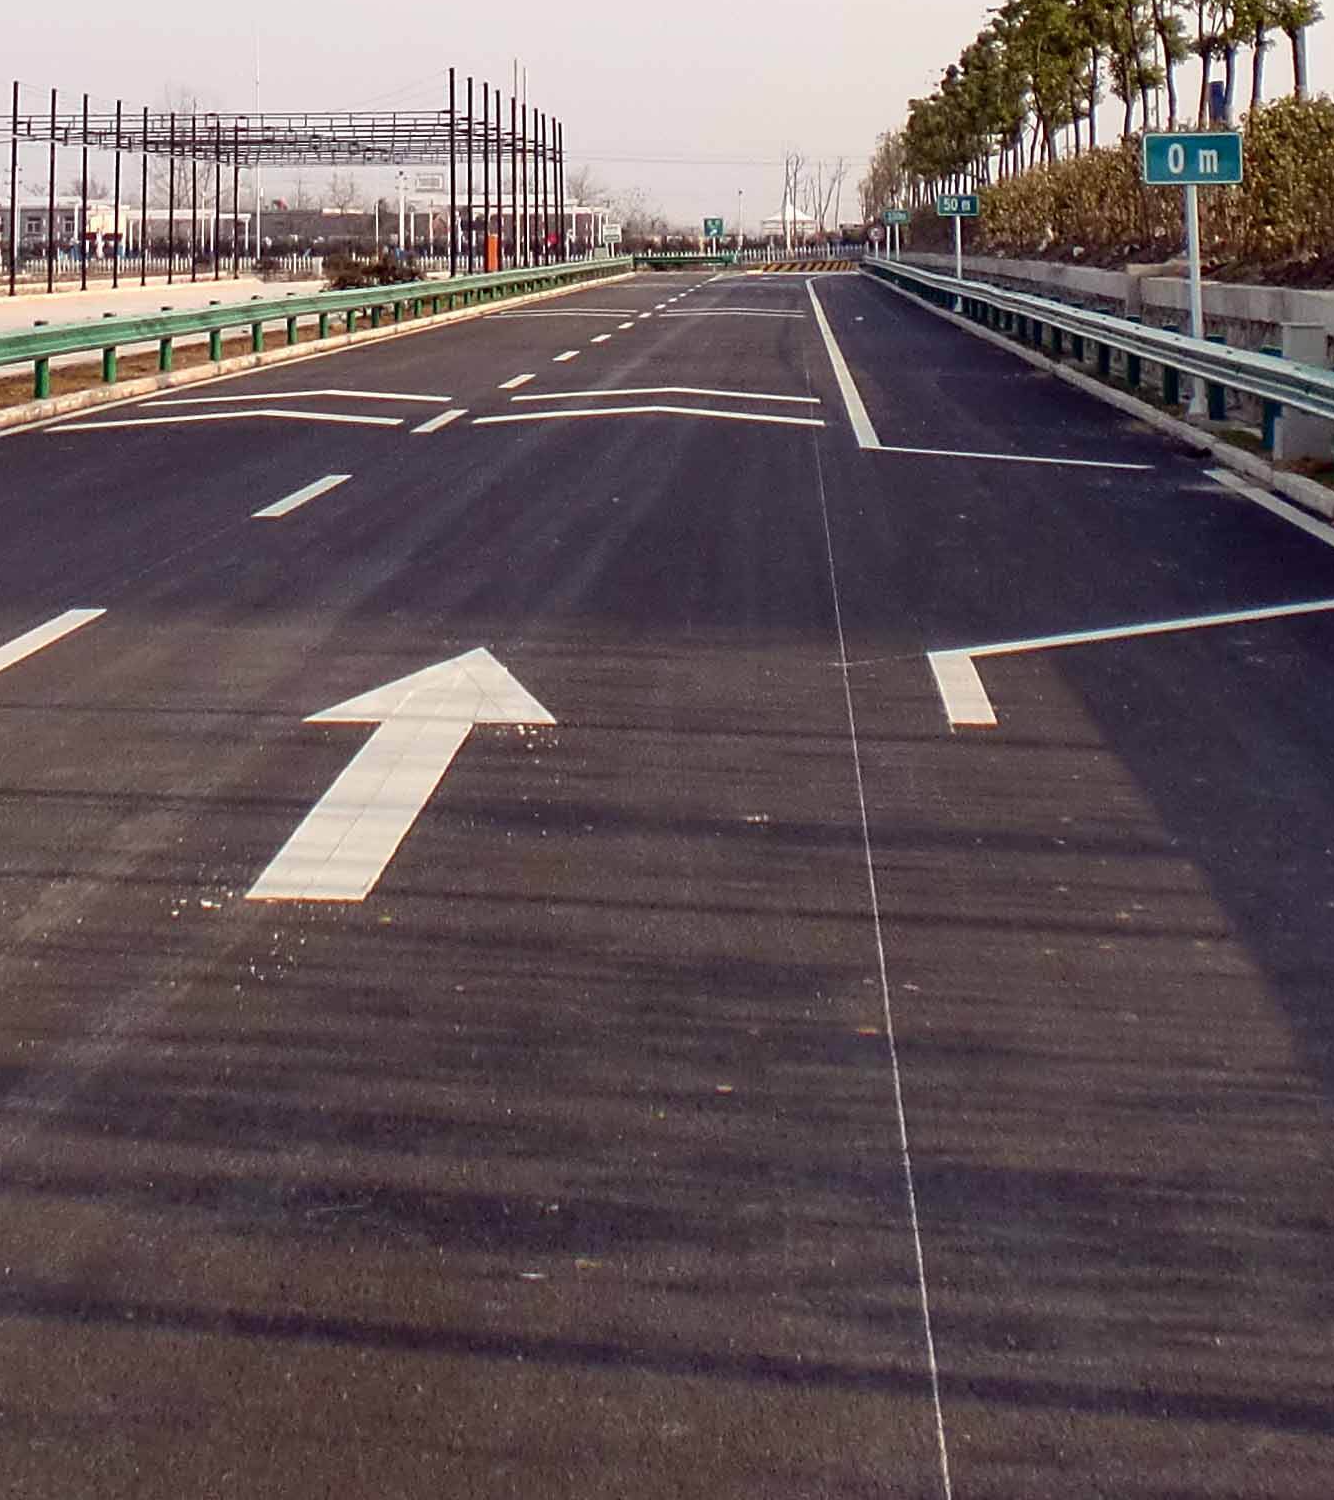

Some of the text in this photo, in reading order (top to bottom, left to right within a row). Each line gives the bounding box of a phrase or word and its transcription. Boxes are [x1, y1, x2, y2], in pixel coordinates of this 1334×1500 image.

[1168, 143, 1218, 174] 0 m
[943, 198, 958, 211] 50
